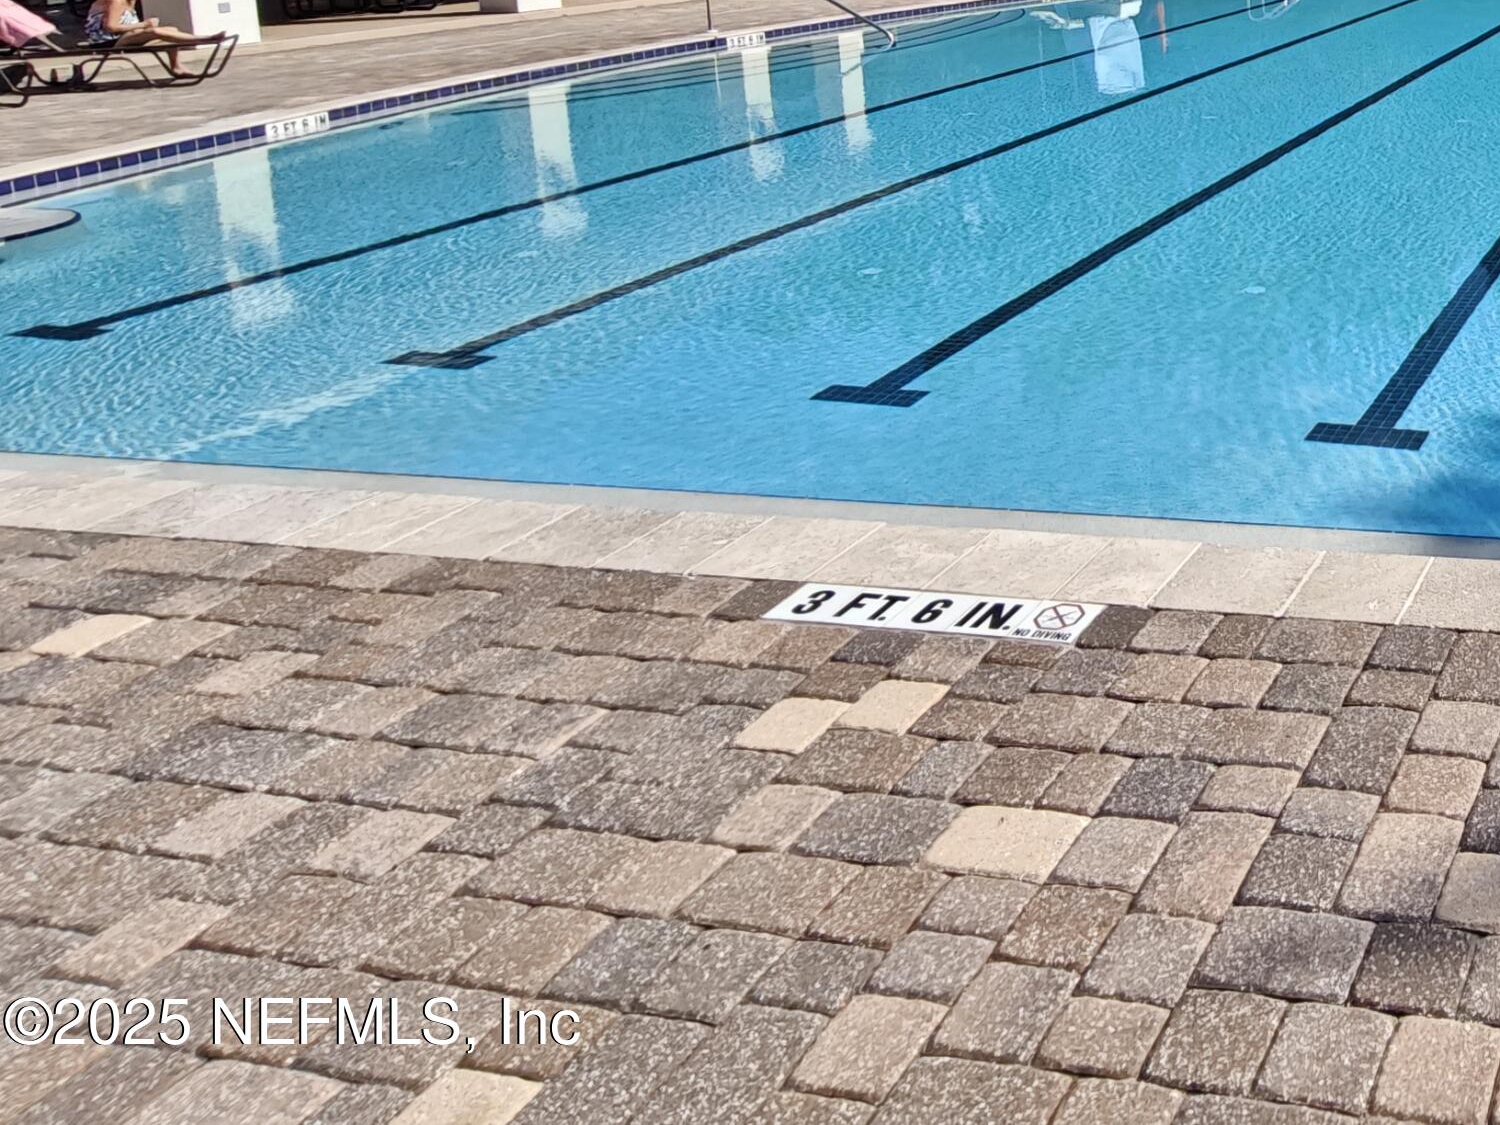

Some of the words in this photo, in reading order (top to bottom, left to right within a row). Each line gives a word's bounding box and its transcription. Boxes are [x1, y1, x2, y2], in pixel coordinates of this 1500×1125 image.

[791, 590, 836, 614] 3
[833, 592, 909, 621] FT.
[911, 598, 953, 624] 6
[954, 601, 1024, 630] IN.
[1012, 628, 1031, 637] NO
[1031, 630, 1072, 641] DIVING
